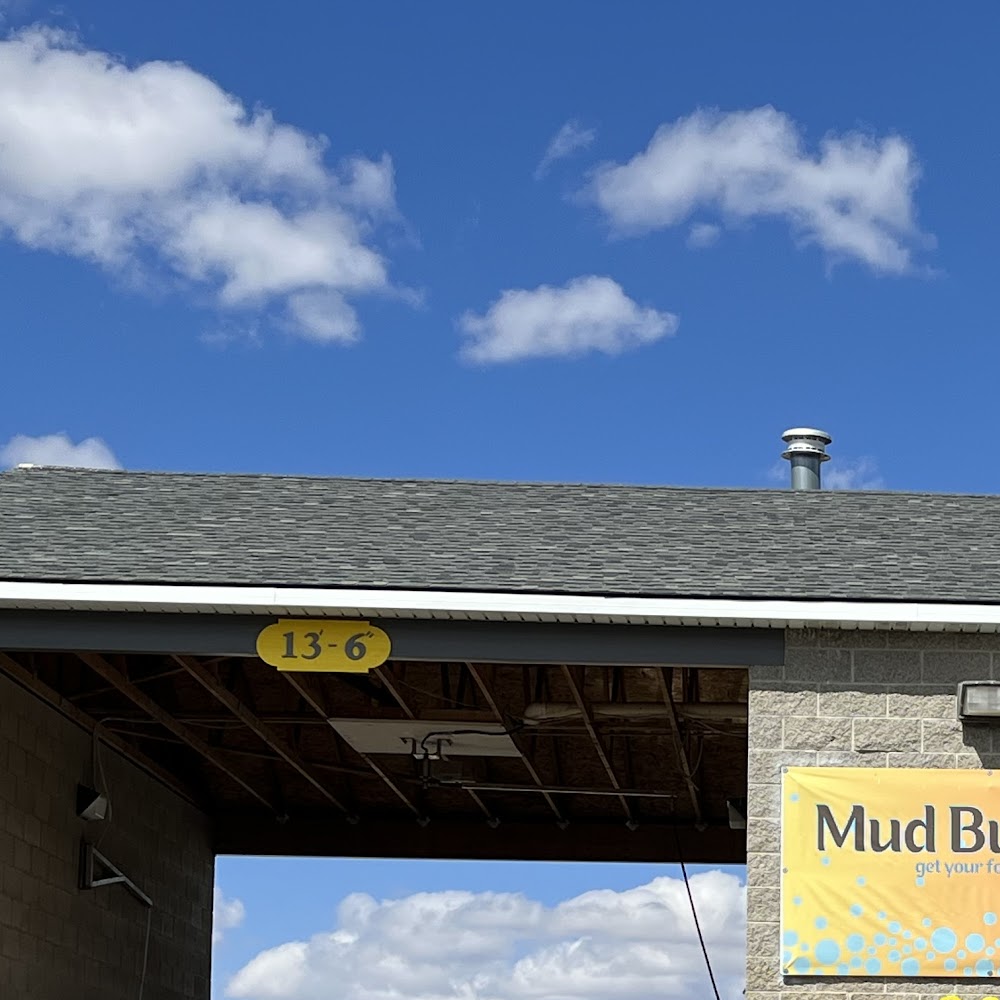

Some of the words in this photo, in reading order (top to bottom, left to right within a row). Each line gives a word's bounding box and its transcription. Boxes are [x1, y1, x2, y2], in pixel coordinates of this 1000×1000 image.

[816, 804, 936, 853] Mud
[915, 859, 941, 877] get
[944, 862, 984, 877] your
